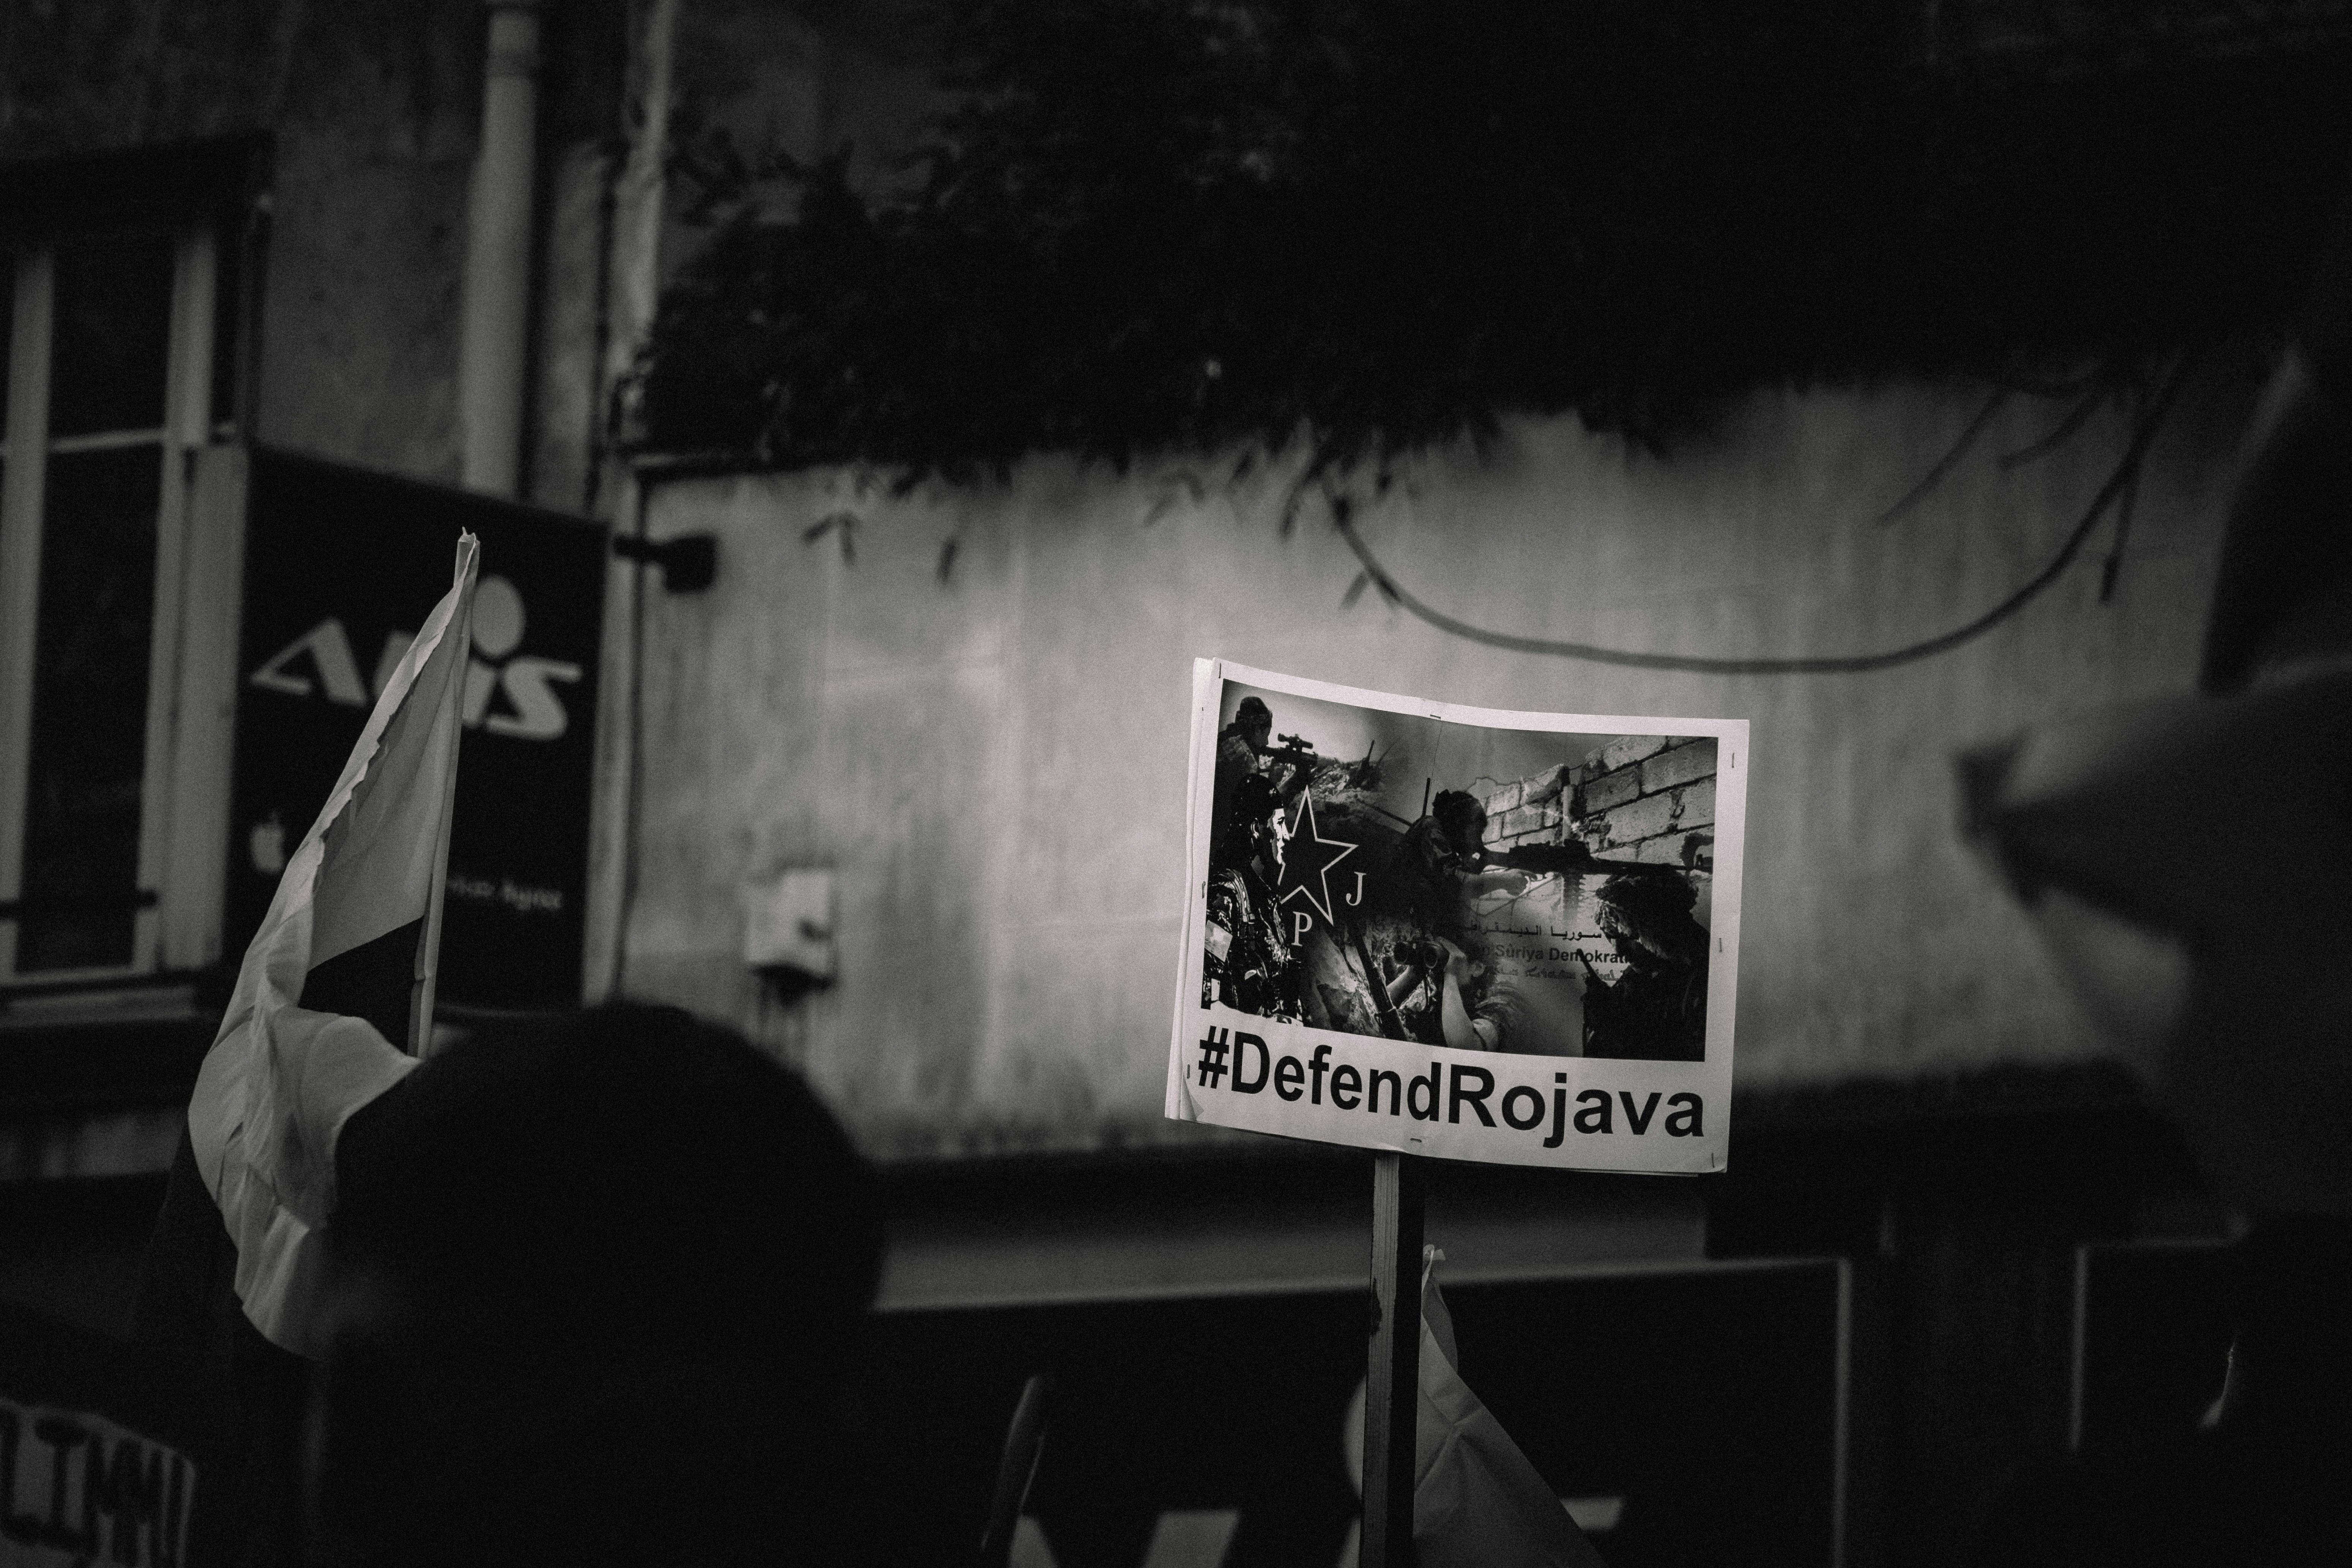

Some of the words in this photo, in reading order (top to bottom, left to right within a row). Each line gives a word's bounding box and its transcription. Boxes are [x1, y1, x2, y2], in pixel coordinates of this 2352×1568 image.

[1345, 871, 1367, 906] J
[1291, 911, 1313, 947] P
[1198, 1024, 1706, 1149] #DefendRojava
